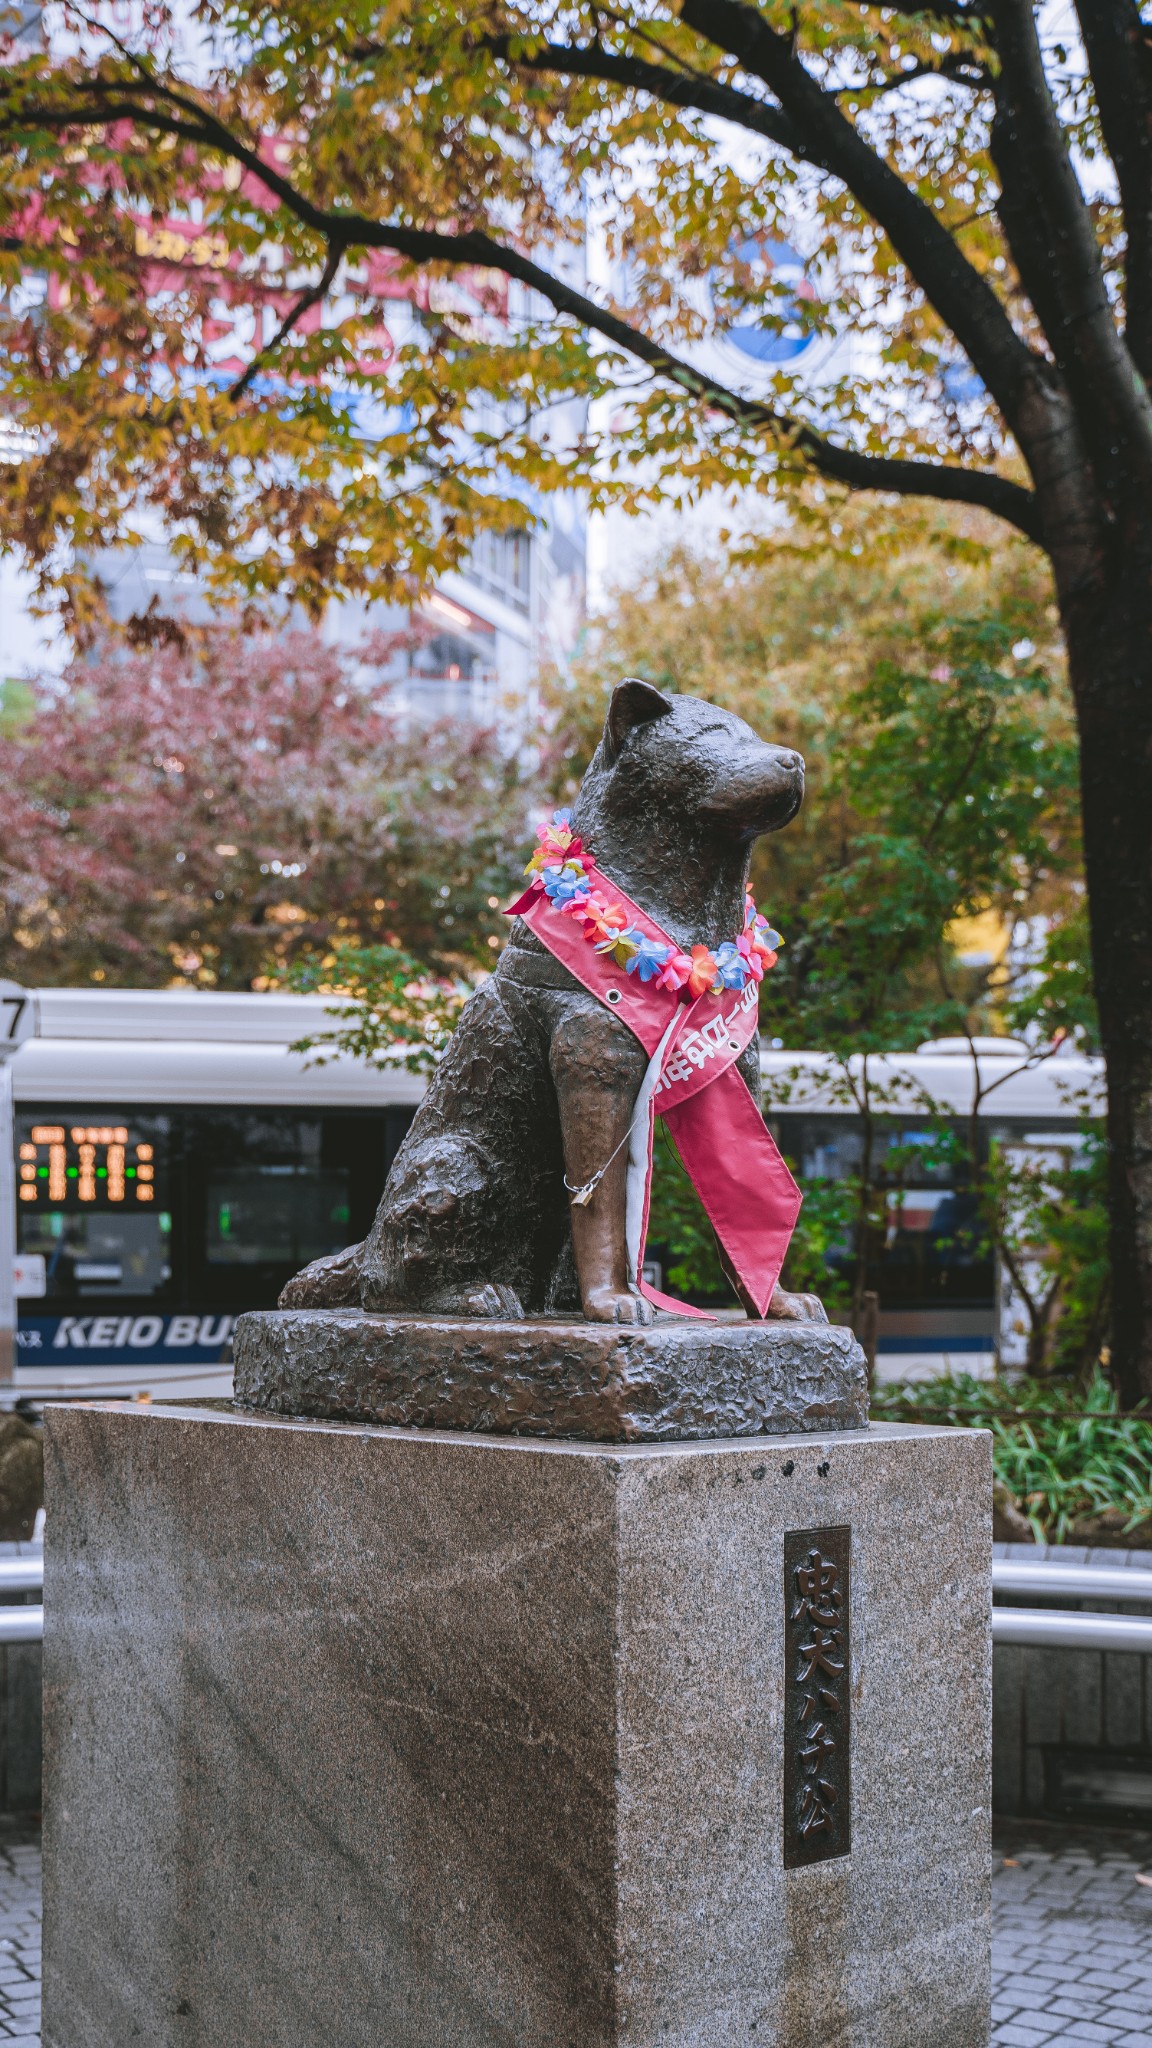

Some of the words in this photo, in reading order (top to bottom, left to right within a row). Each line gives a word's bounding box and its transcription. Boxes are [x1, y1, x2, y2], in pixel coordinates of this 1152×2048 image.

[2, 997, 26, 1030] 7
[53, 1315, 164, 1348] KEIO
[790, 1549, 845, 1842] 忠犬ハチ公
